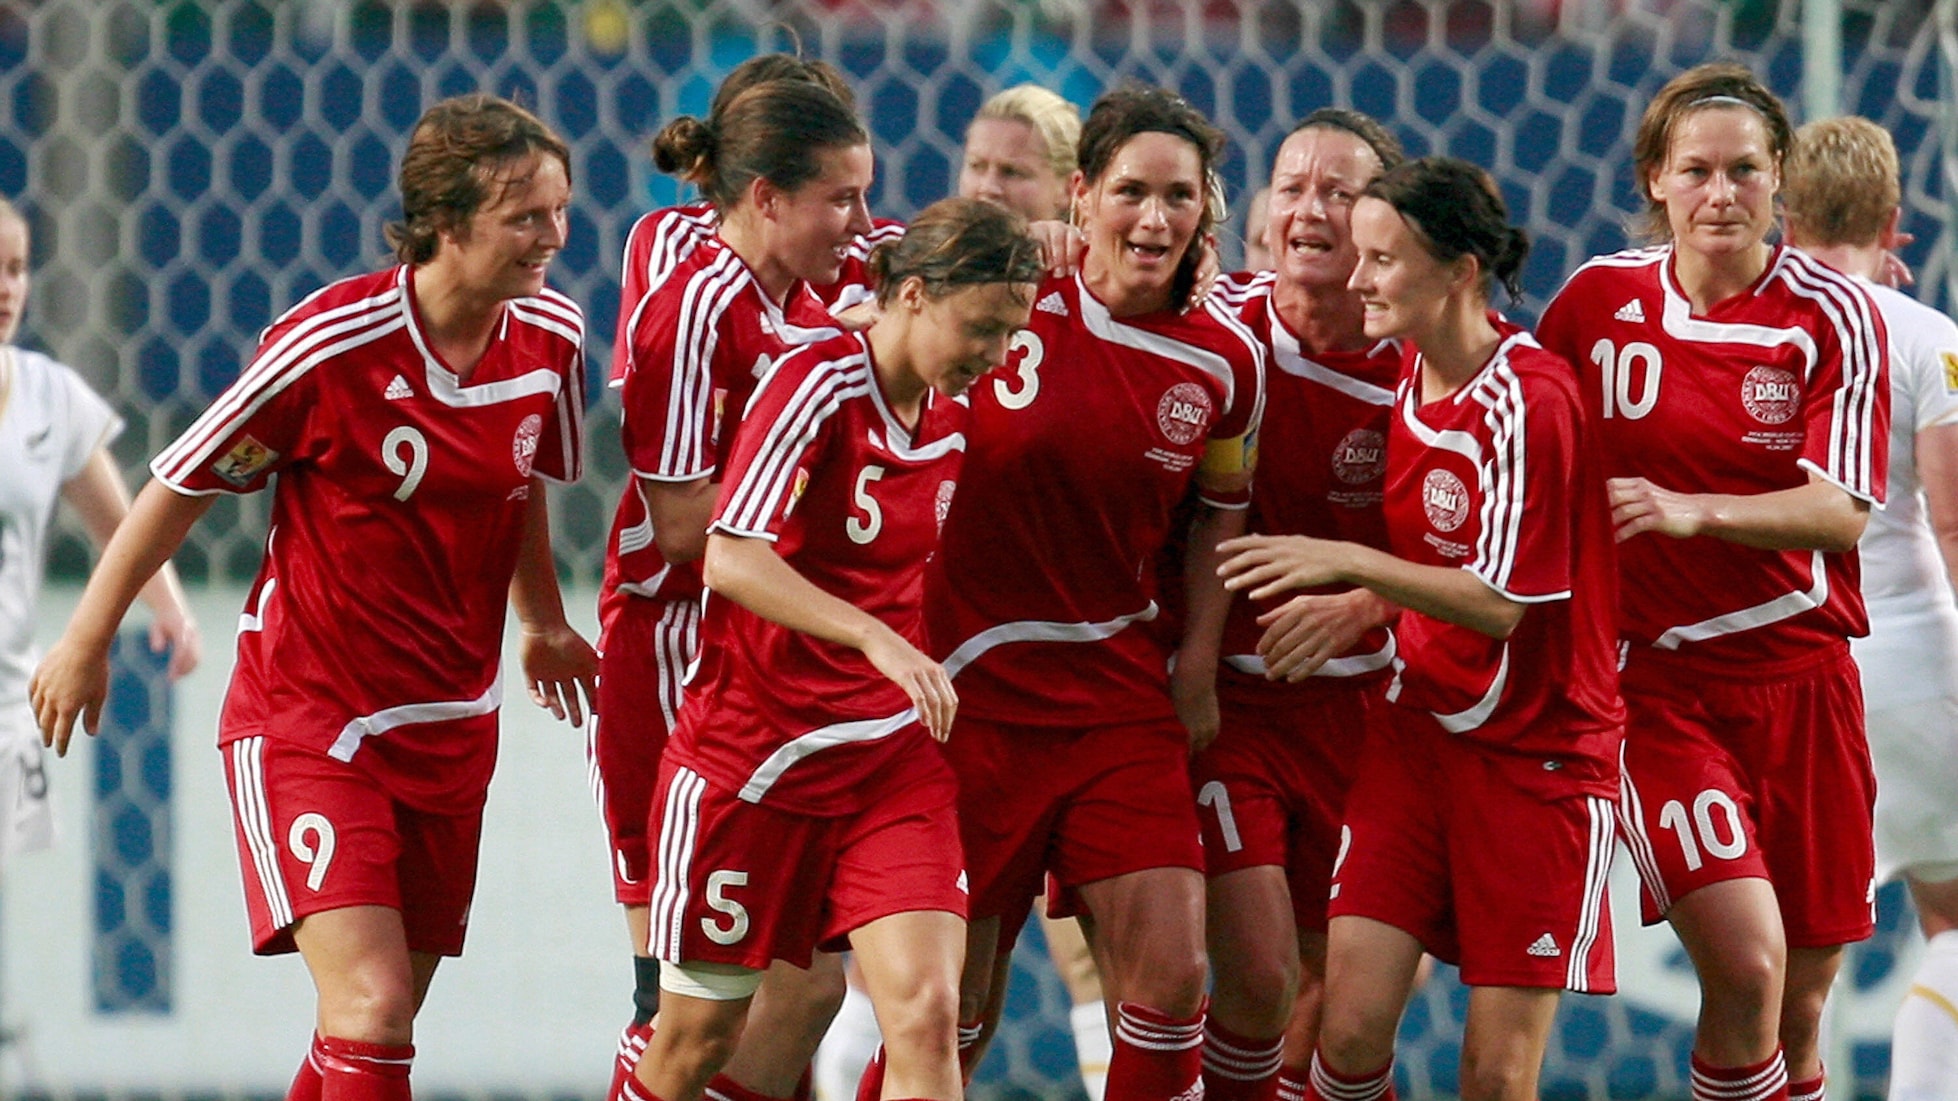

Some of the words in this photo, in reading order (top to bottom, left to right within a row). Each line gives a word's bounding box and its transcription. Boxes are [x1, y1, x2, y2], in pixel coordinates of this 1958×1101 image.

[993, 329, 1043, 410] 3
[1591, 338, 1662, 420] 10
[1755, 383, 1789, 401] DBU
[1170, 401, 1203, 425] DBU
[382, 426, 427, 502] 9
[1343, 447, 1379, 464] DBU
[846, 465, 885, 544] 5
[1431, 488, 1456, 512] DBU
[288, 812, 335, 892] 9
[1659, 789, 1746, 871] 10
[700, 869, 749, 945] 5
